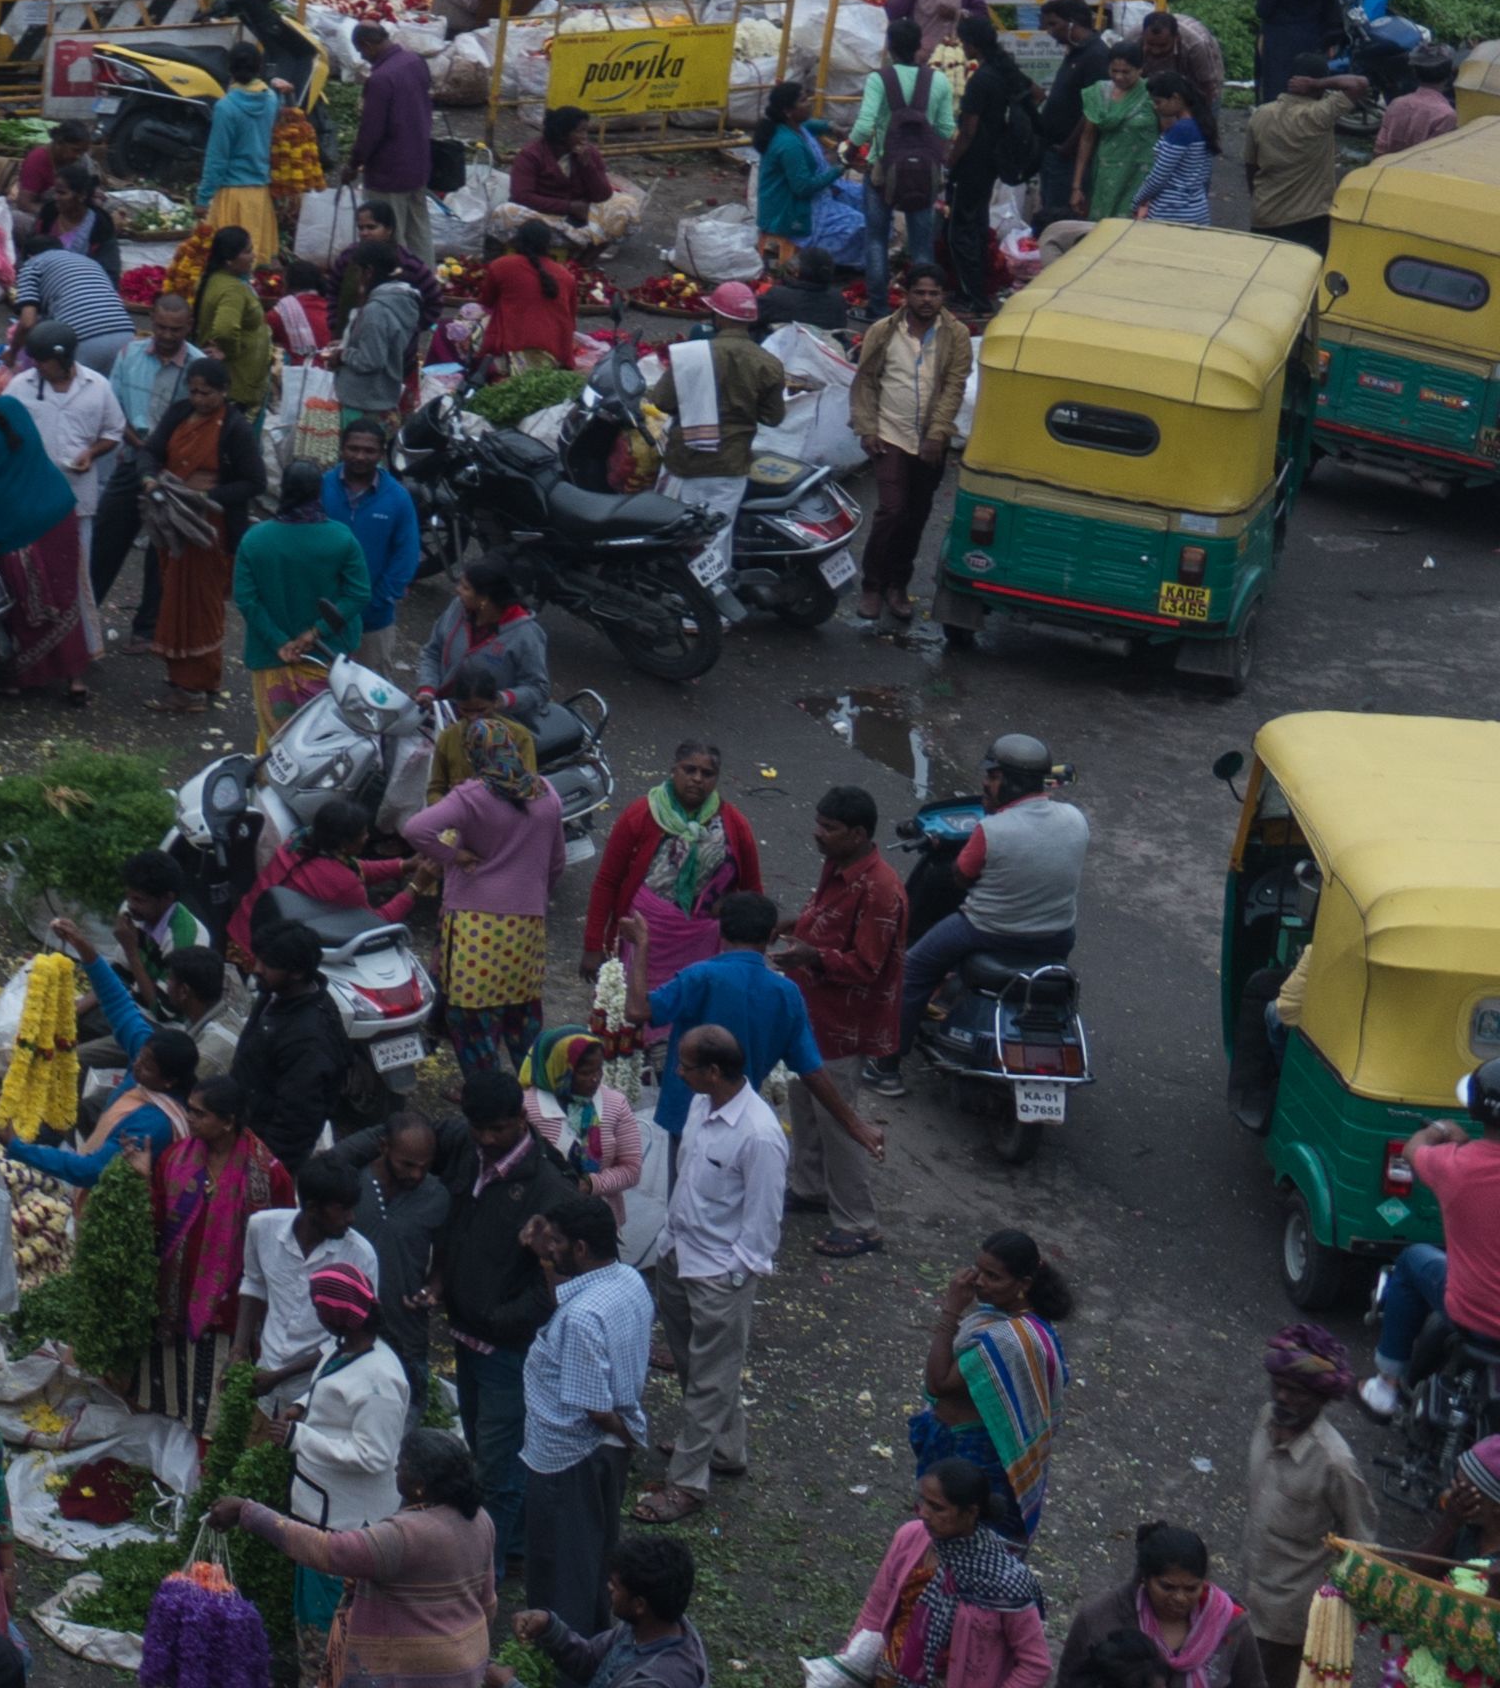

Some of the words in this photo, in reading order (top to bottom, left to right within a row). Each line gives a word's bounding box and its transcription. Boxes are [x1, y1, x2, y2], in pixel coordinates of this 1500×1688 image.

[579, 43, 685, 98] poorvika
[1166, 586, 1206, 603] KA02
[1023, 1089, 1059, 1103] KA-01
